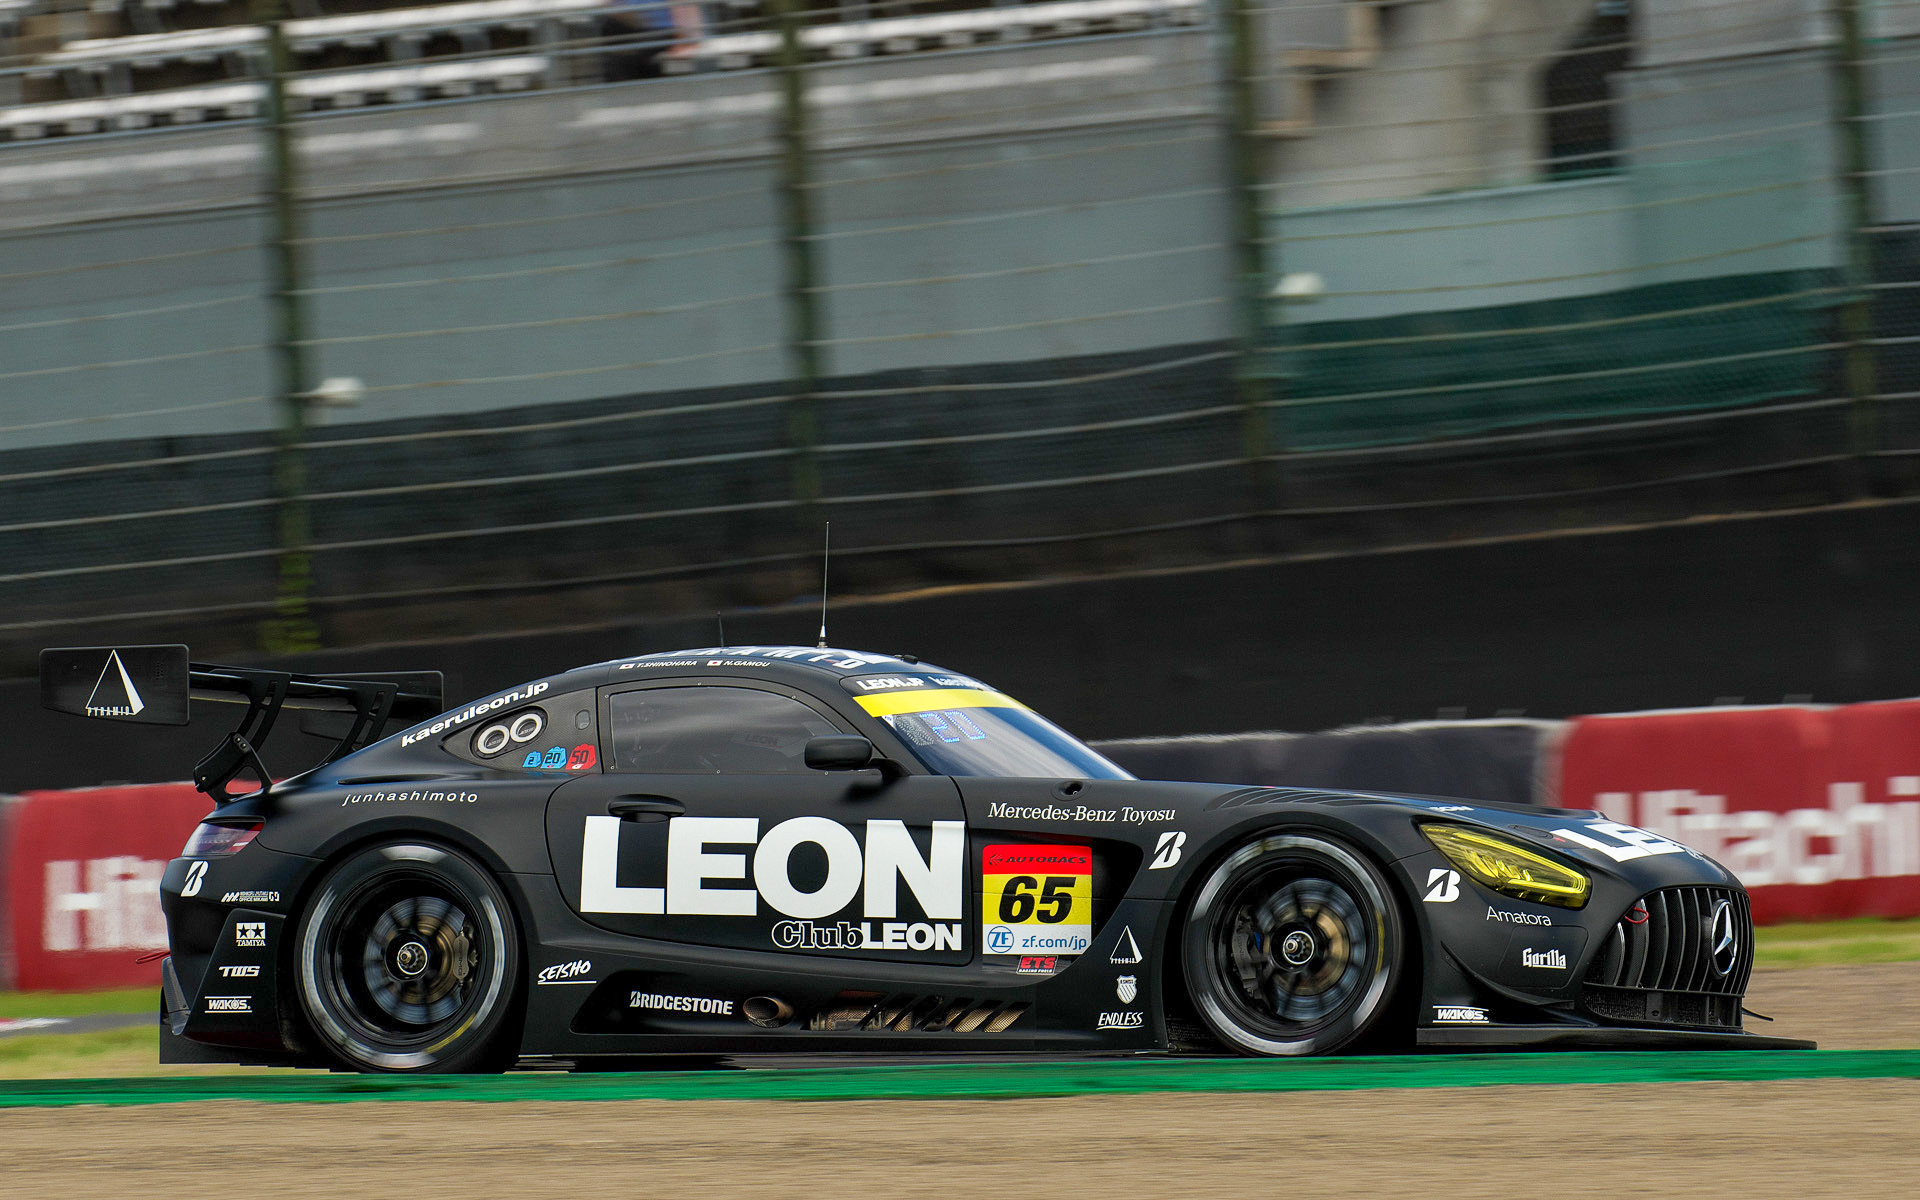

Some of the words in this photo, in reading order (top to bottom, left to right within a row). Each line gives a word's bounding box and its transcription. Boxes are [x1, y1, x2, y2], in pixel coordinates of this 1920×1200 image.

[401, 681, 549, 748] kaeruleon.jp
[545, 752, 561, 764] 20
[571, 750, 589, 764] 50
[341, 790, 478, 806] junhashimoto
[988, 803, 1116, 821] Mercedes-Benz
[1121, 806, 1176, 825] Toyosu
[580, 815, 966, 919] LEON
[1006, 856, 1087, 864] AUTOBACS
[998, 875, 1077, 924] 65
[1486, 905, 1552, 927] Amatora
[989, 930, 1012, 949] ZF
[1021, 935, 1087, 950] zf.com/jp
[1020, 957, 1056, 969] ETS
[1522, 947, 1566, 968] Gorilla
[219, 965, 261, 977] TWS
[538, 960, 592, 982] SEISHO
[630, 991, 734, 1015] BRIDGESTONE
[1098, 1011, 1144, 1026] ENDLESS
